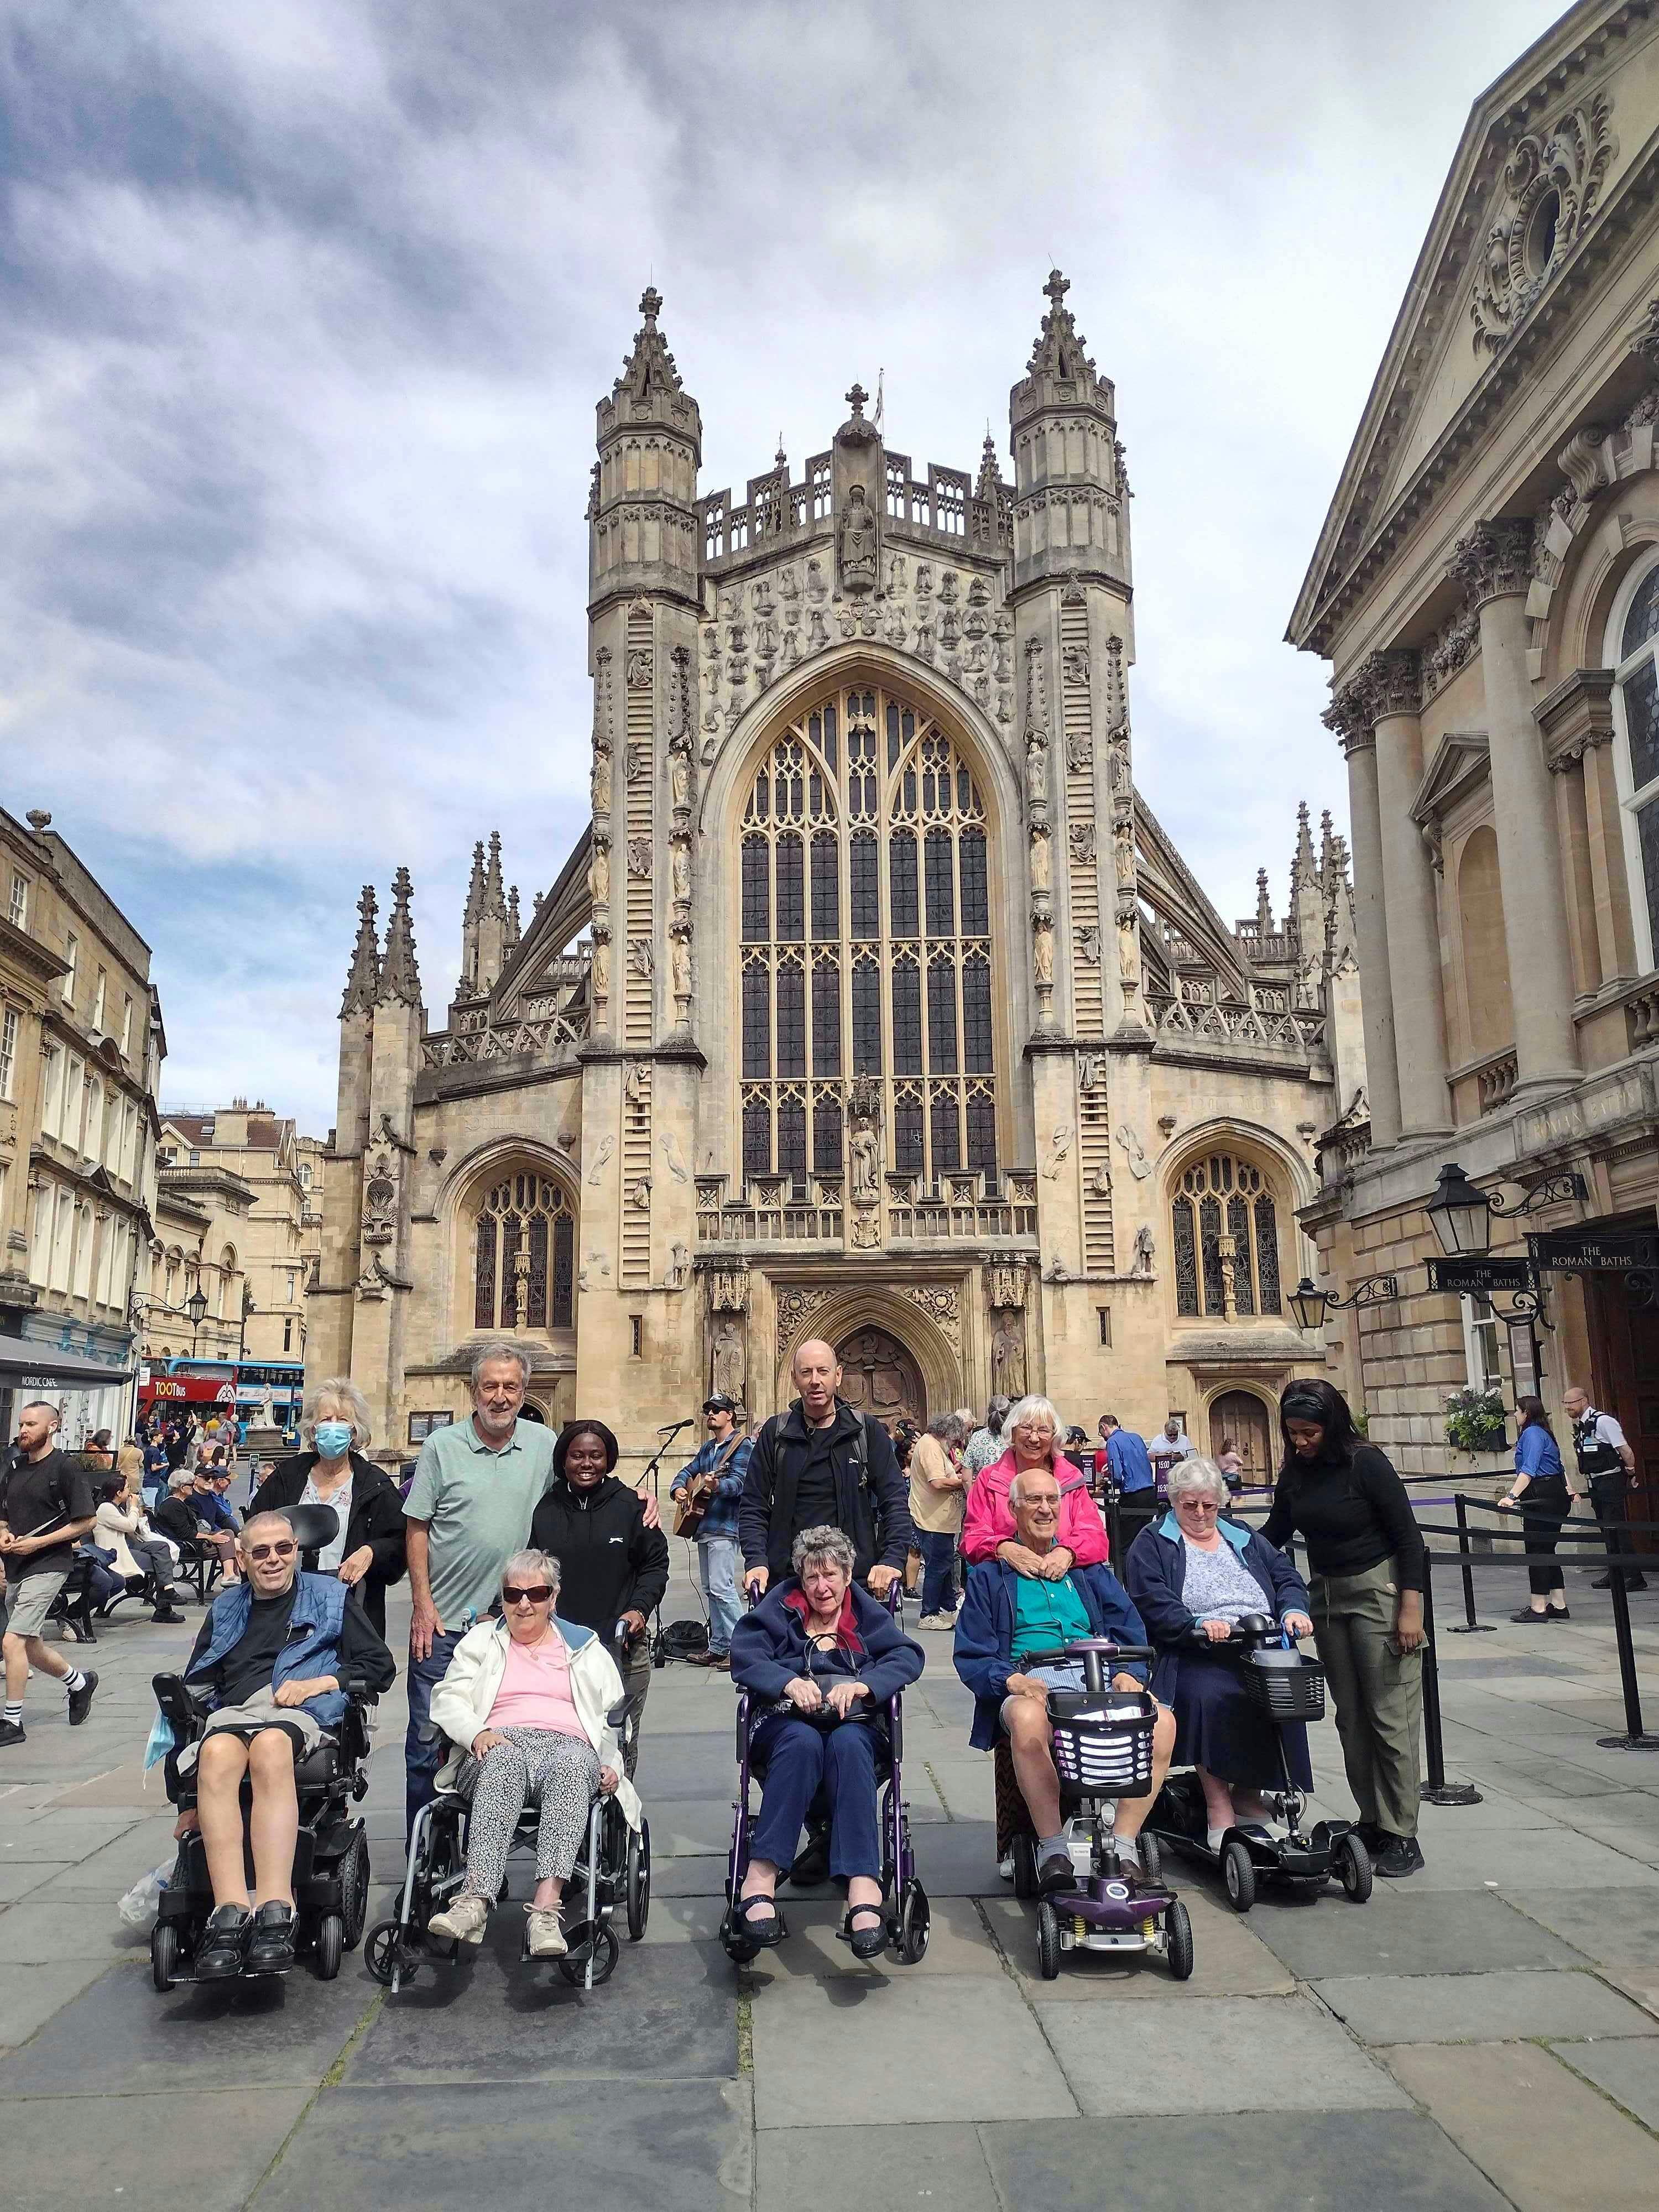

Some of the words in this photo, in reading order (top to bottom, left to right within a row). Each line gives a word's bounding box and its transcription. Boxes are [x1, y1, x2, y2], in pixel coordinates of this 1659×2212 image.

[1581, 1246, 1601, 1256] THE
[1552, 1256, 1593, 1266] ROMAN
[1601, 1256, 1632, 1266] BATHS
[1474, 1270, 1491, 1278] THE
[1447, 1279, 1483, 1287] ROMAN
[1493, 1278, 1520, 1287] BATHS
[22, 1376, 42, 1387] NORDIC
[42, 1378, 58, 1387] CAFE
